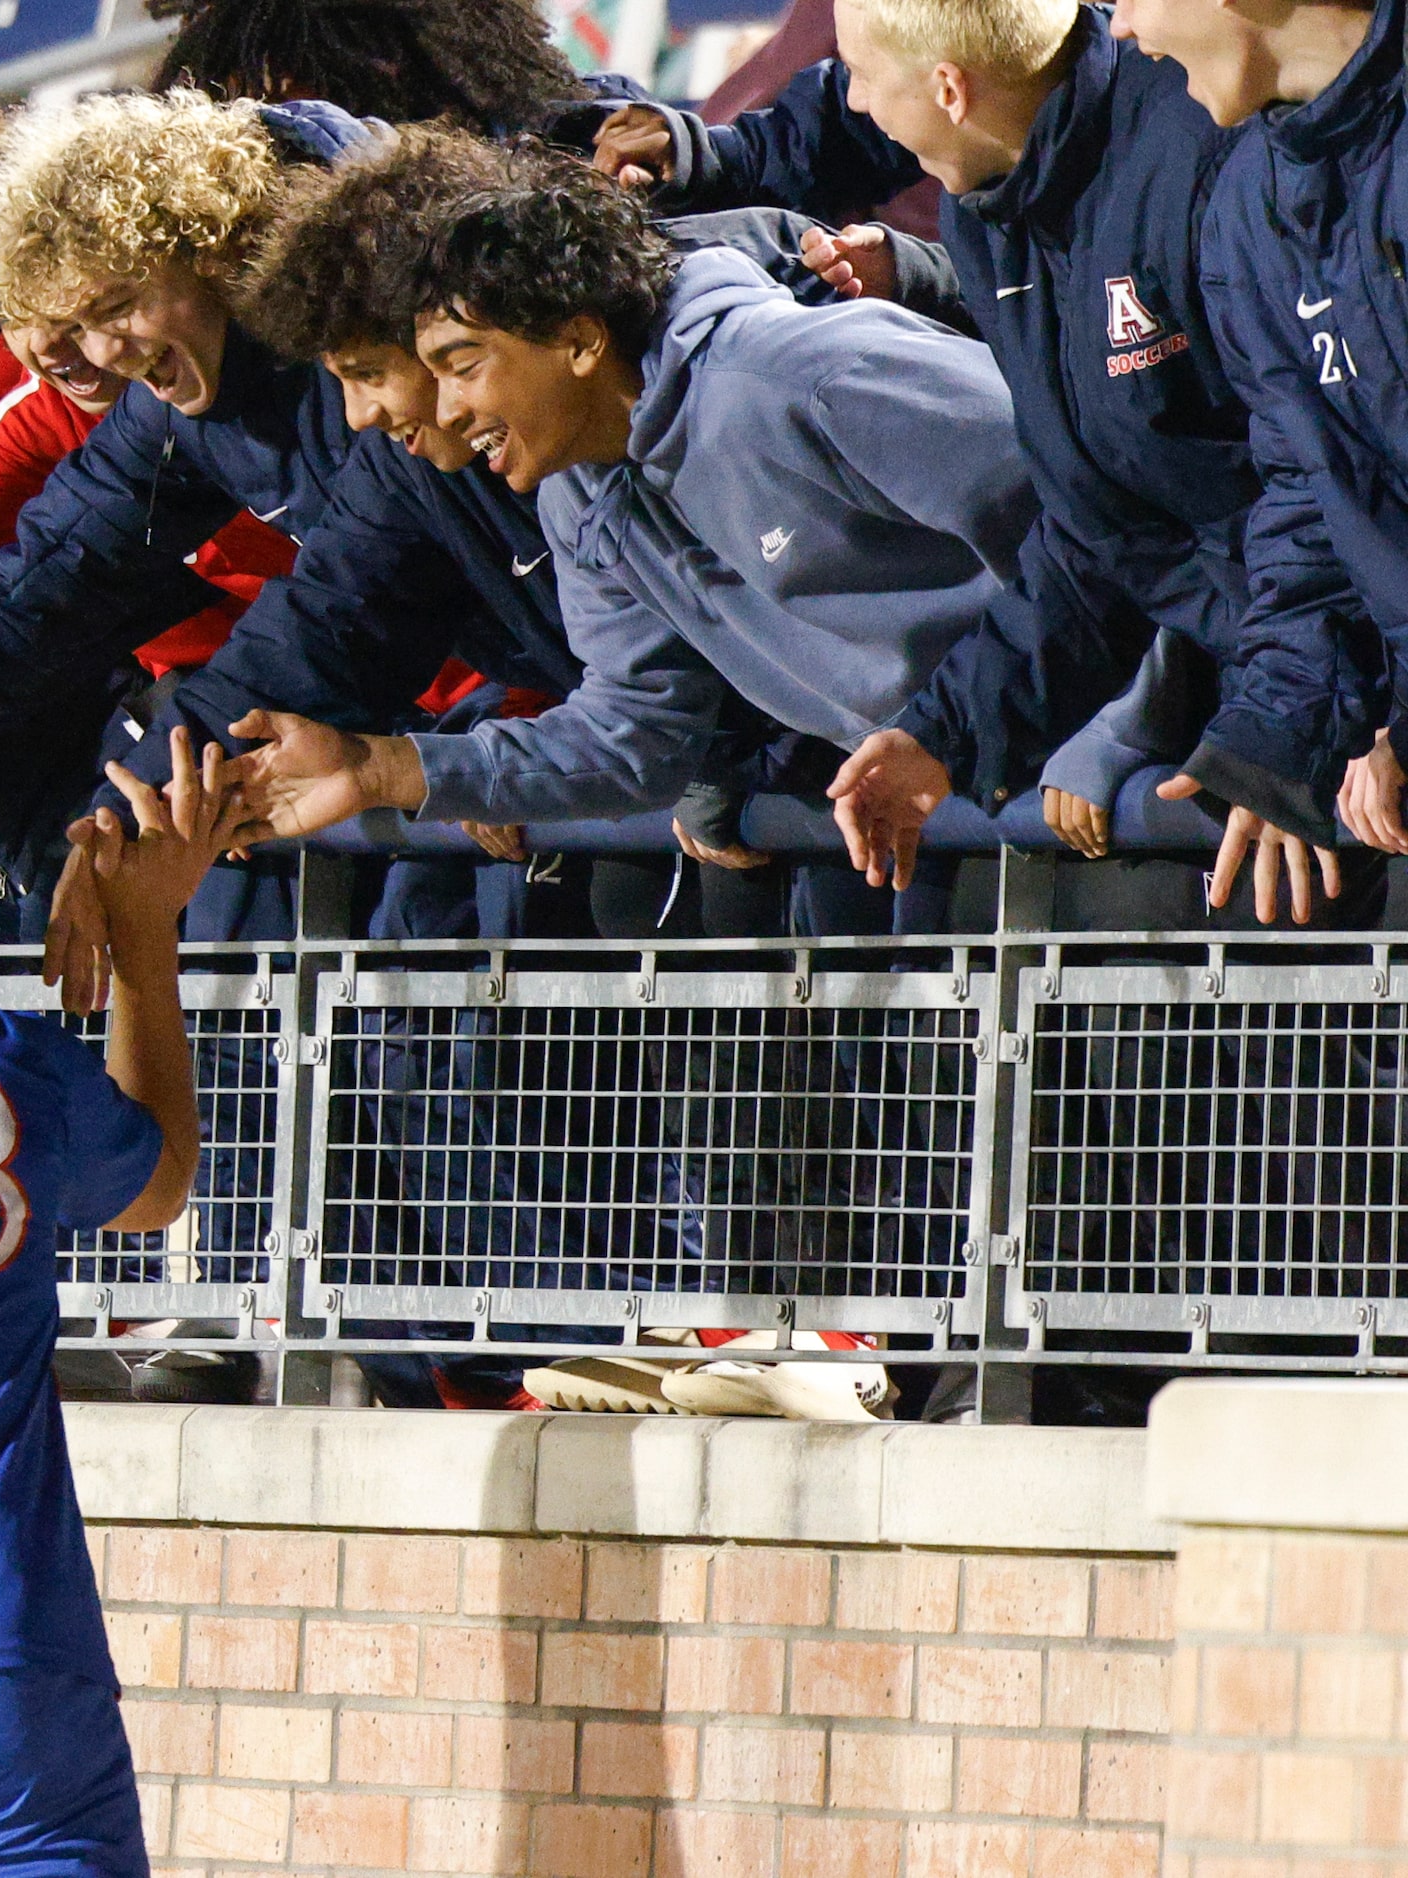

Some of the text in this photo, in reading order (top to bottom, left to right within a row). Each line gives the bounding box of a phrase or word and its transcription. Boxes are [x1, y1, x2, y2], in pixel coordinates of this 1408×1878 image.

[1104, 276, 1164, 348] A
[1107, 333, 1189, 378] SOCCER
[759, 526, 786, 552] NIKE
